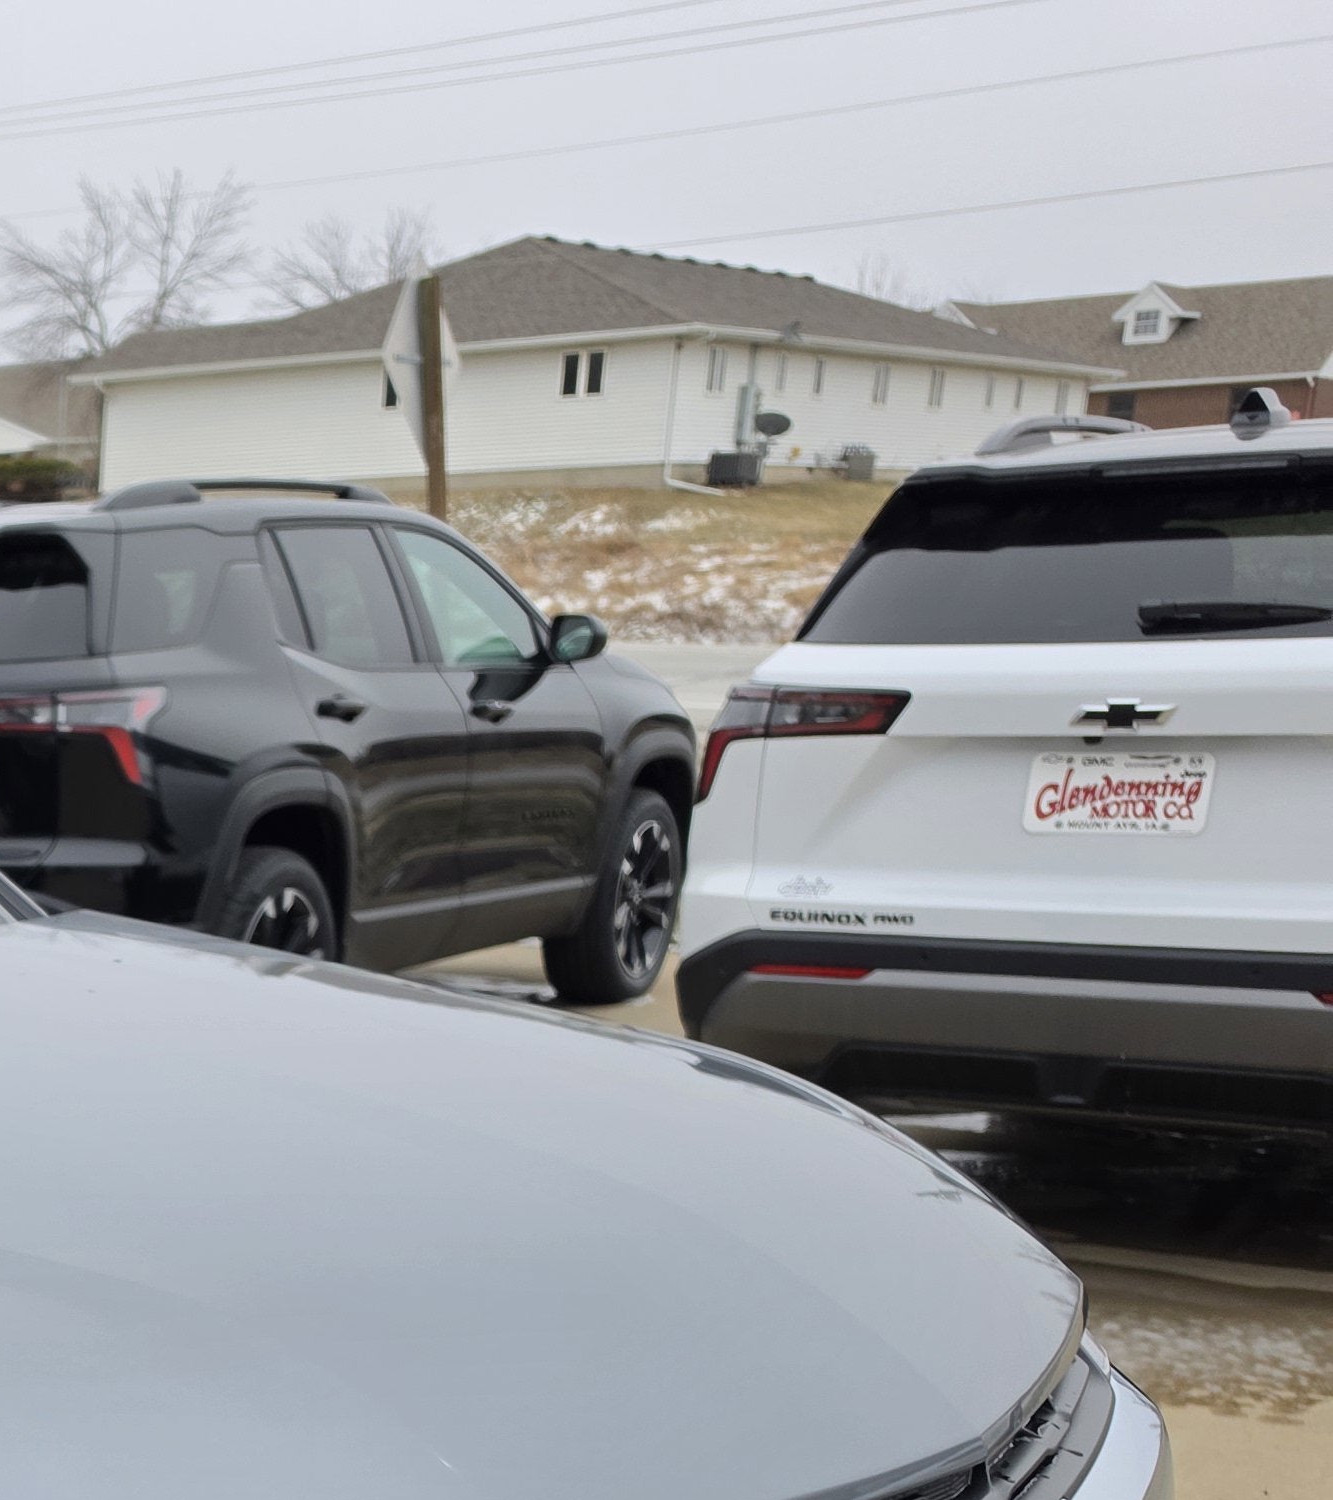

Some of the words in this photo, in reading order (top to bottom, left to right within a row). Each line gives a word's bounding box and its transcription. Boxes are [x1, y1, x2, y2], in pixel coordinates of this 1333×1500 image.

[1035, 767, 1204, 821] Glendenning
[1090, 798, 1157, 820] MOTOR
[770, 908, 866, 926] EQUINOX
[873, 912, 915, 925] AWD
